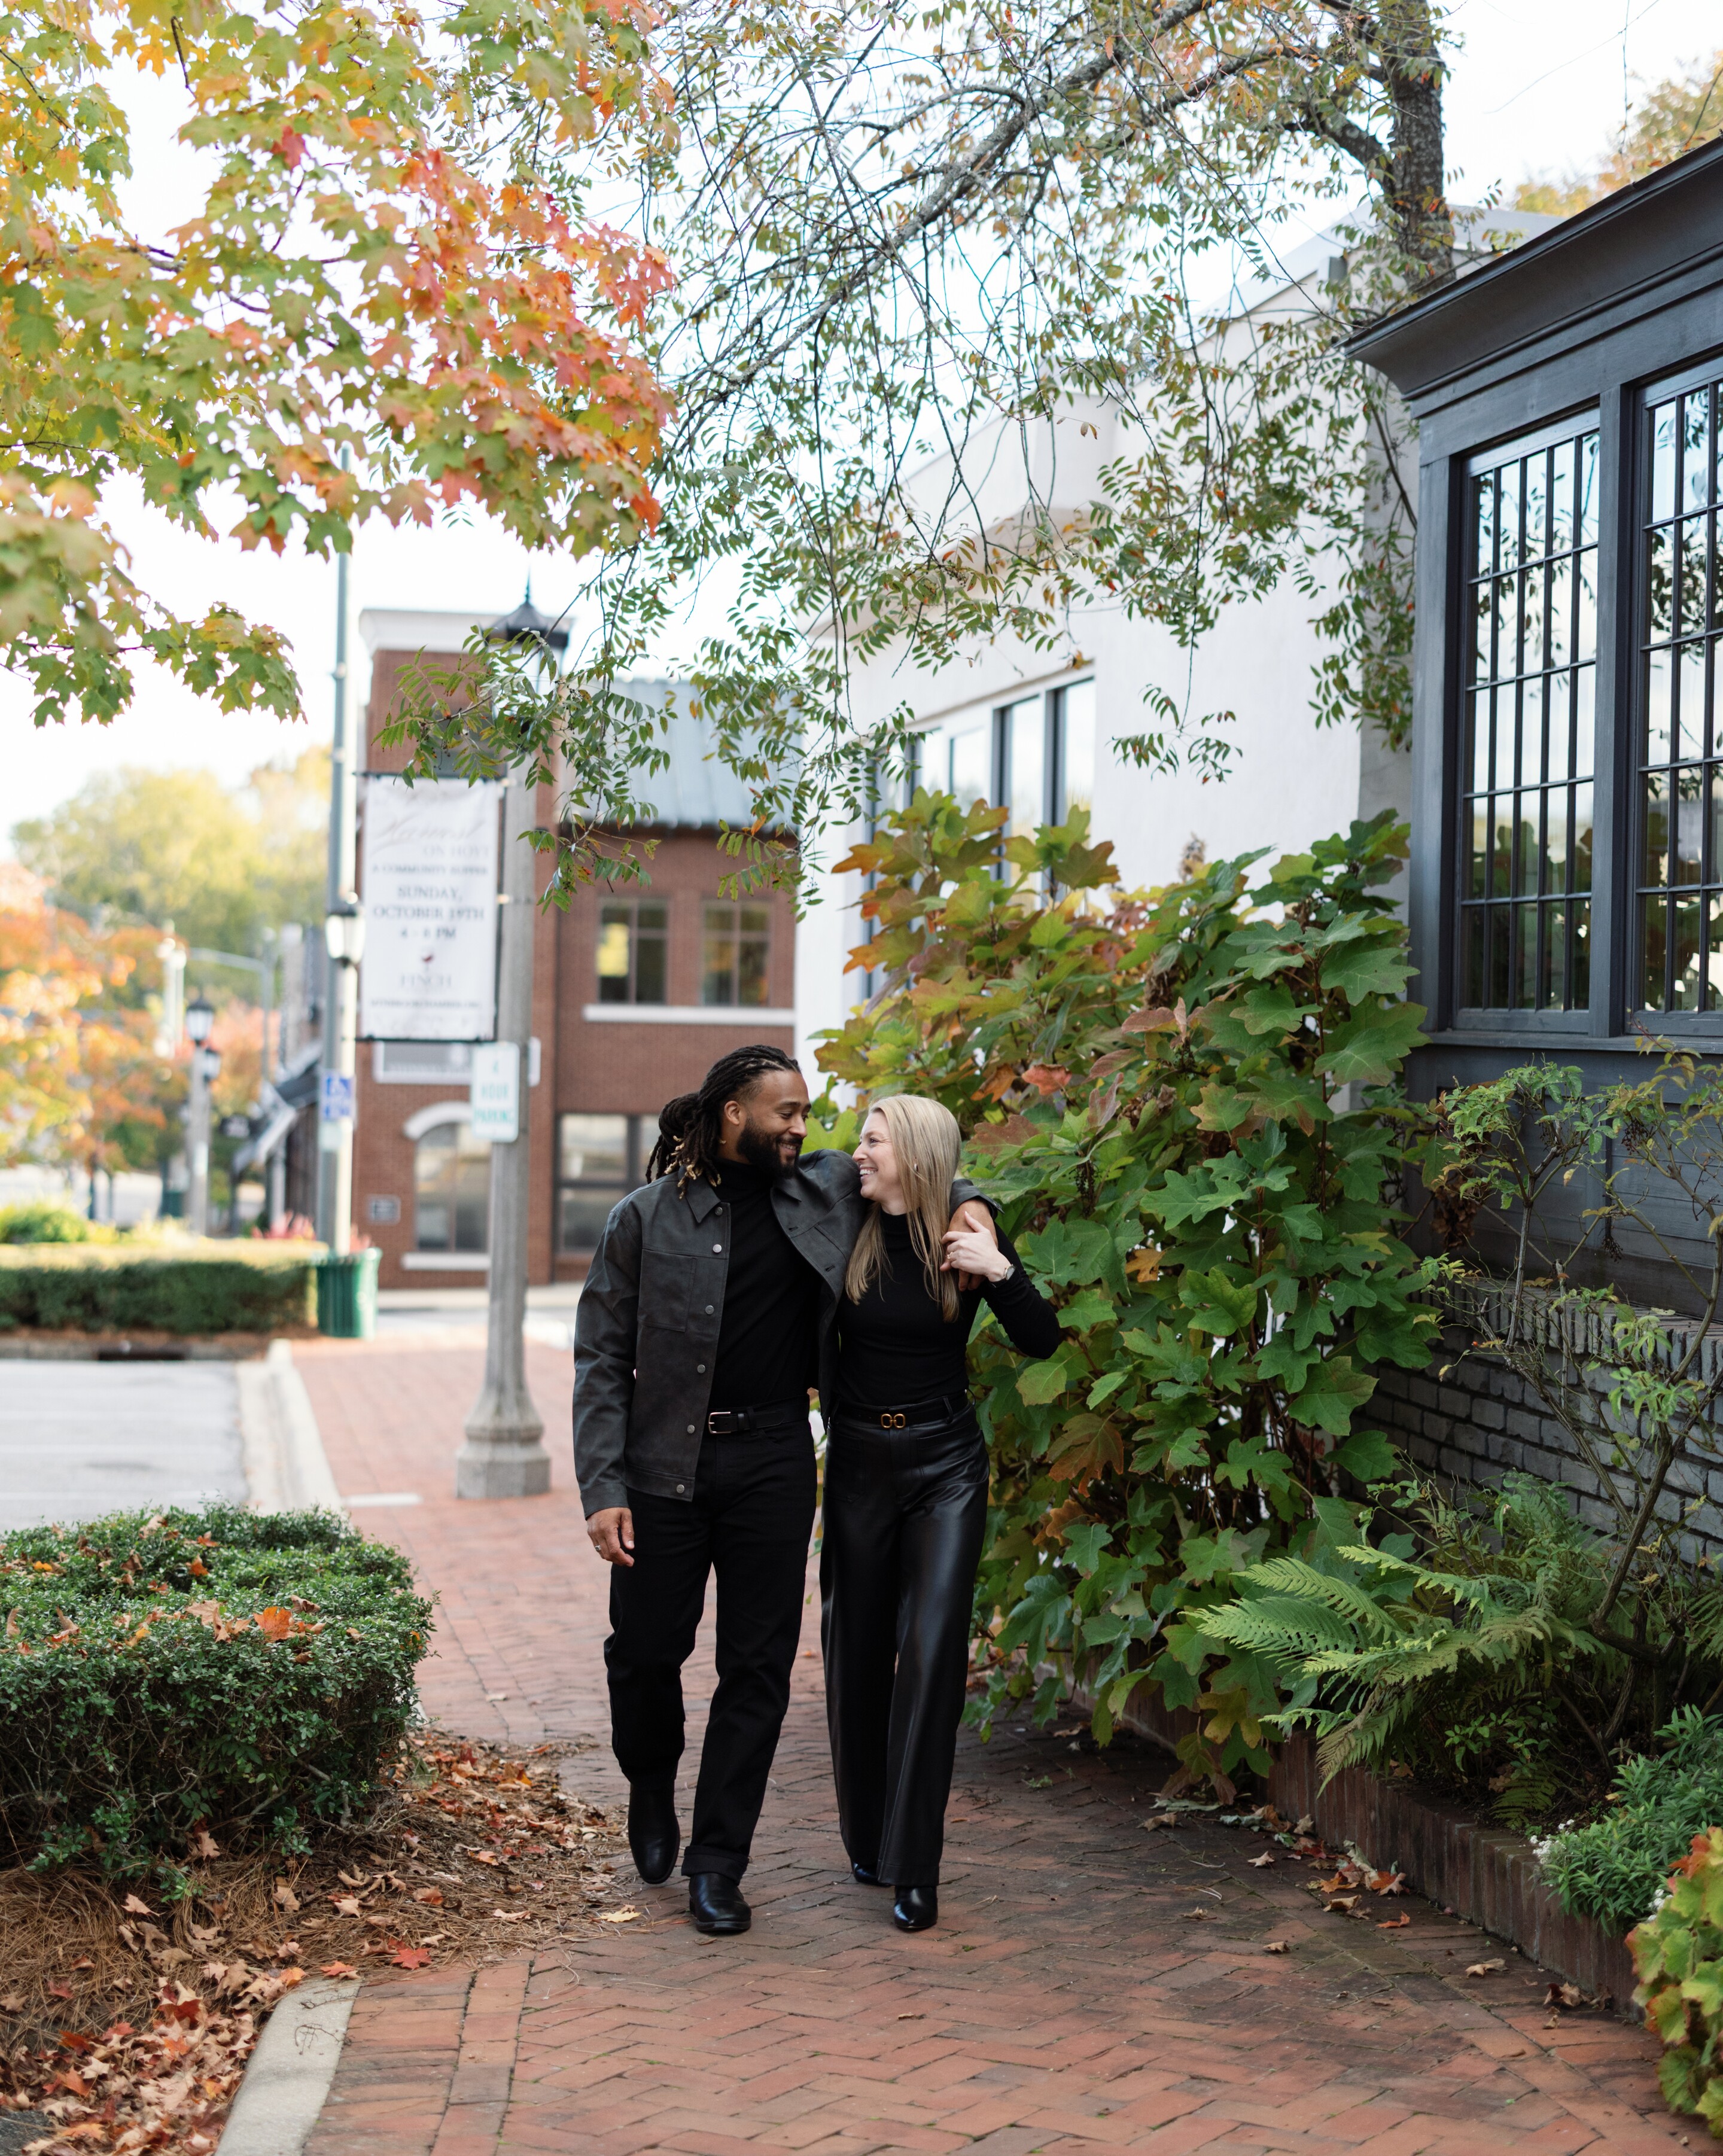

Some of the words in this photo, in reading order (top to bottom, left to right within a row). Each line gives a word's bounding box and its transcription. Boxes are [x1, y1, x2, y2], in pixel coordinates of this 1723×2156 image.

[397, 885, 462, 902] SUNDAY,
[373, 906, 442, 919] OCTOBER
[436, 927, 456, 939] PM
[481, 1084, 509, 1100] HOUR
[476, 1108, 515, 1123] PARKING
